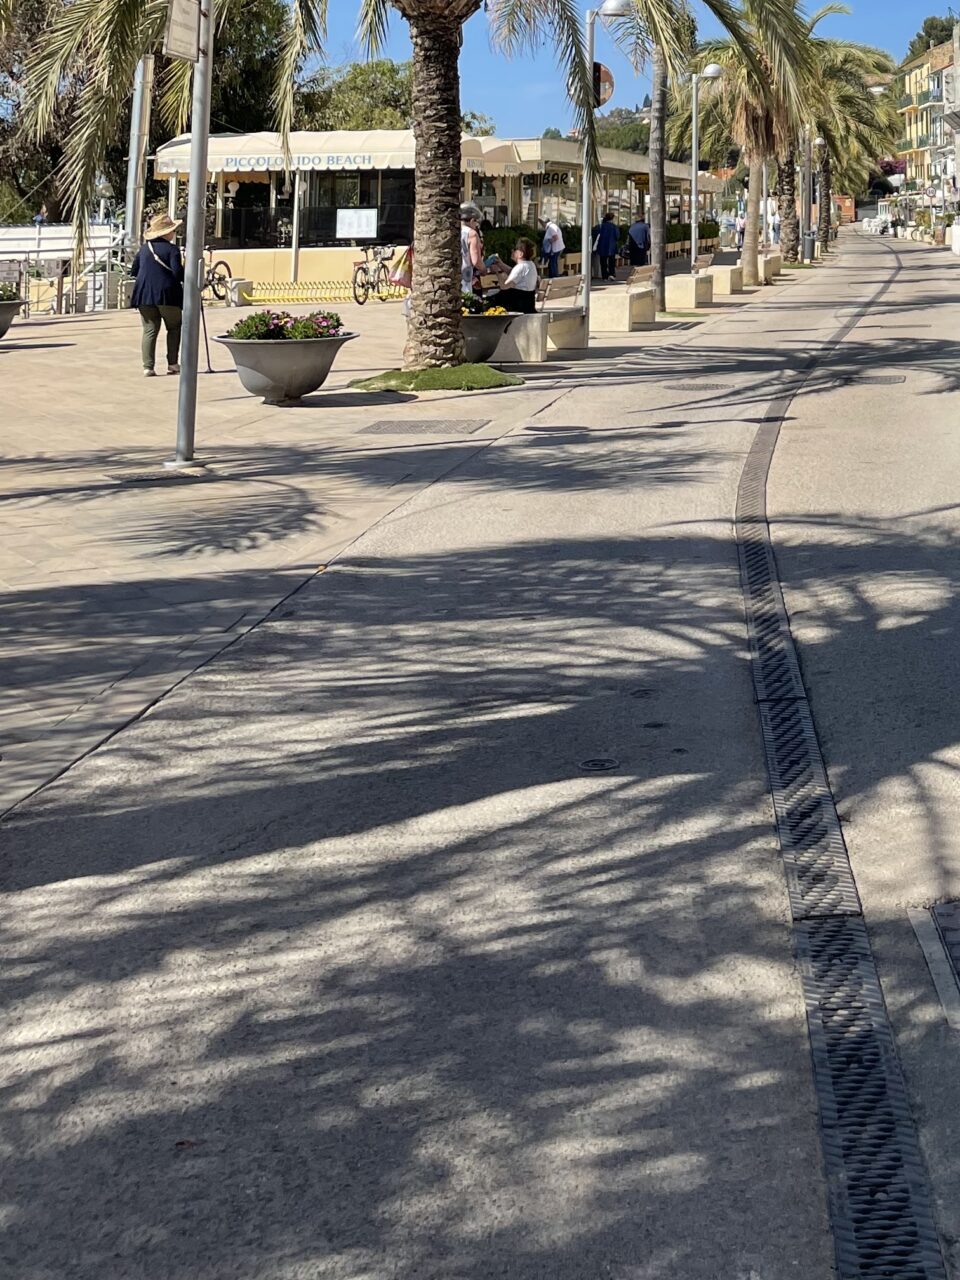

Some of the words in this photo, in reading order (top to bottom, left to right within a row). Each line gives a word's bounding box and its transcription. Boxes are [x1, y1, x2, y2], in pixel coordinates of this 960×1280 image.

[225, 156, 284, 167] PICCOLO
[291, 156, 321, 166] IDO
[327, 155, 372, 165] BEACH
[543, 173, 569, 185] BAR
